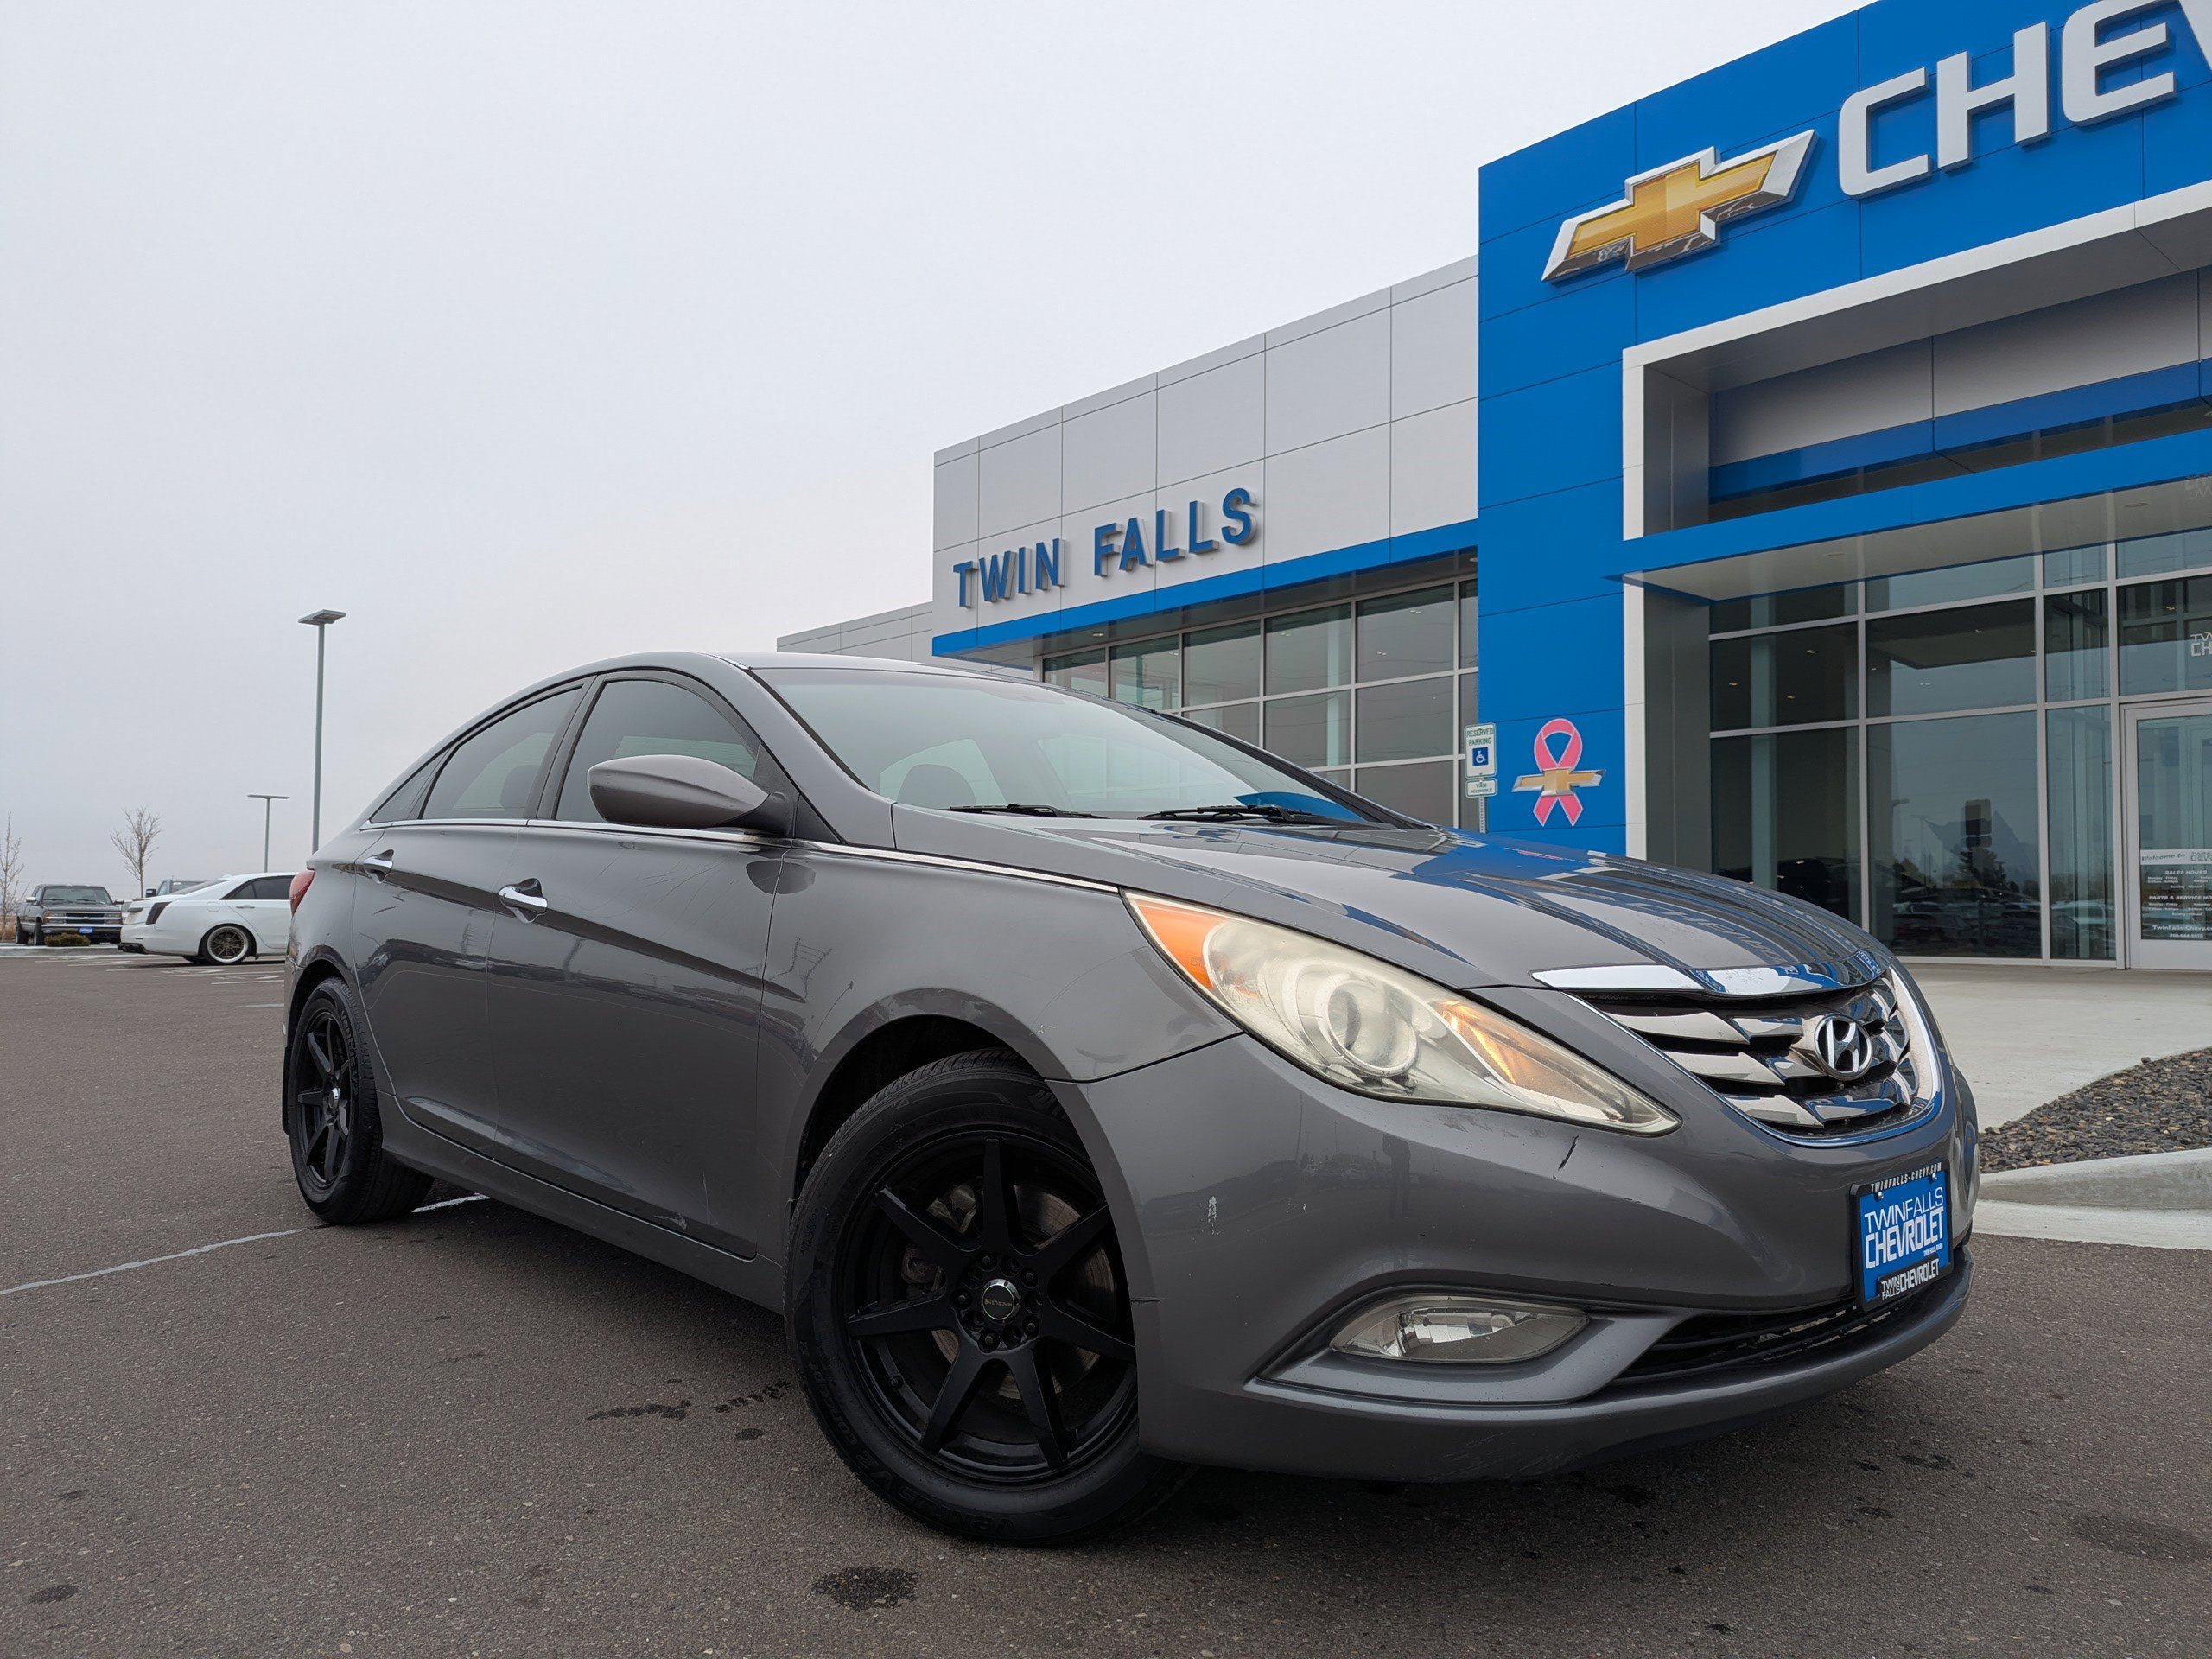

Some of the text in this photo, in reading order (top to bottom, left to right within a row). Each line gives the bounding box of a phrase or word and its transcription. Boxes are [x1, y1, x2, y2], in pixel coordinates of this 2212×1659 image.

[953, 487, 1258, 607] TWIN FALLS
[1466, 728, 1493, 737] RESERVED
[1468, 737, 1492, 746] PARKING
[1871, 1162, 1942, 1193] TWINFALLS-CHEVY.COM
[1866, 1205, 1944, 1269] CHEVROLET
[1880, 1274, 1900, 1291] TWIN
[1899, 1258, 1940, 1293] CHEVROLET
[1881, 1285, 1901, 1300] FALLS
